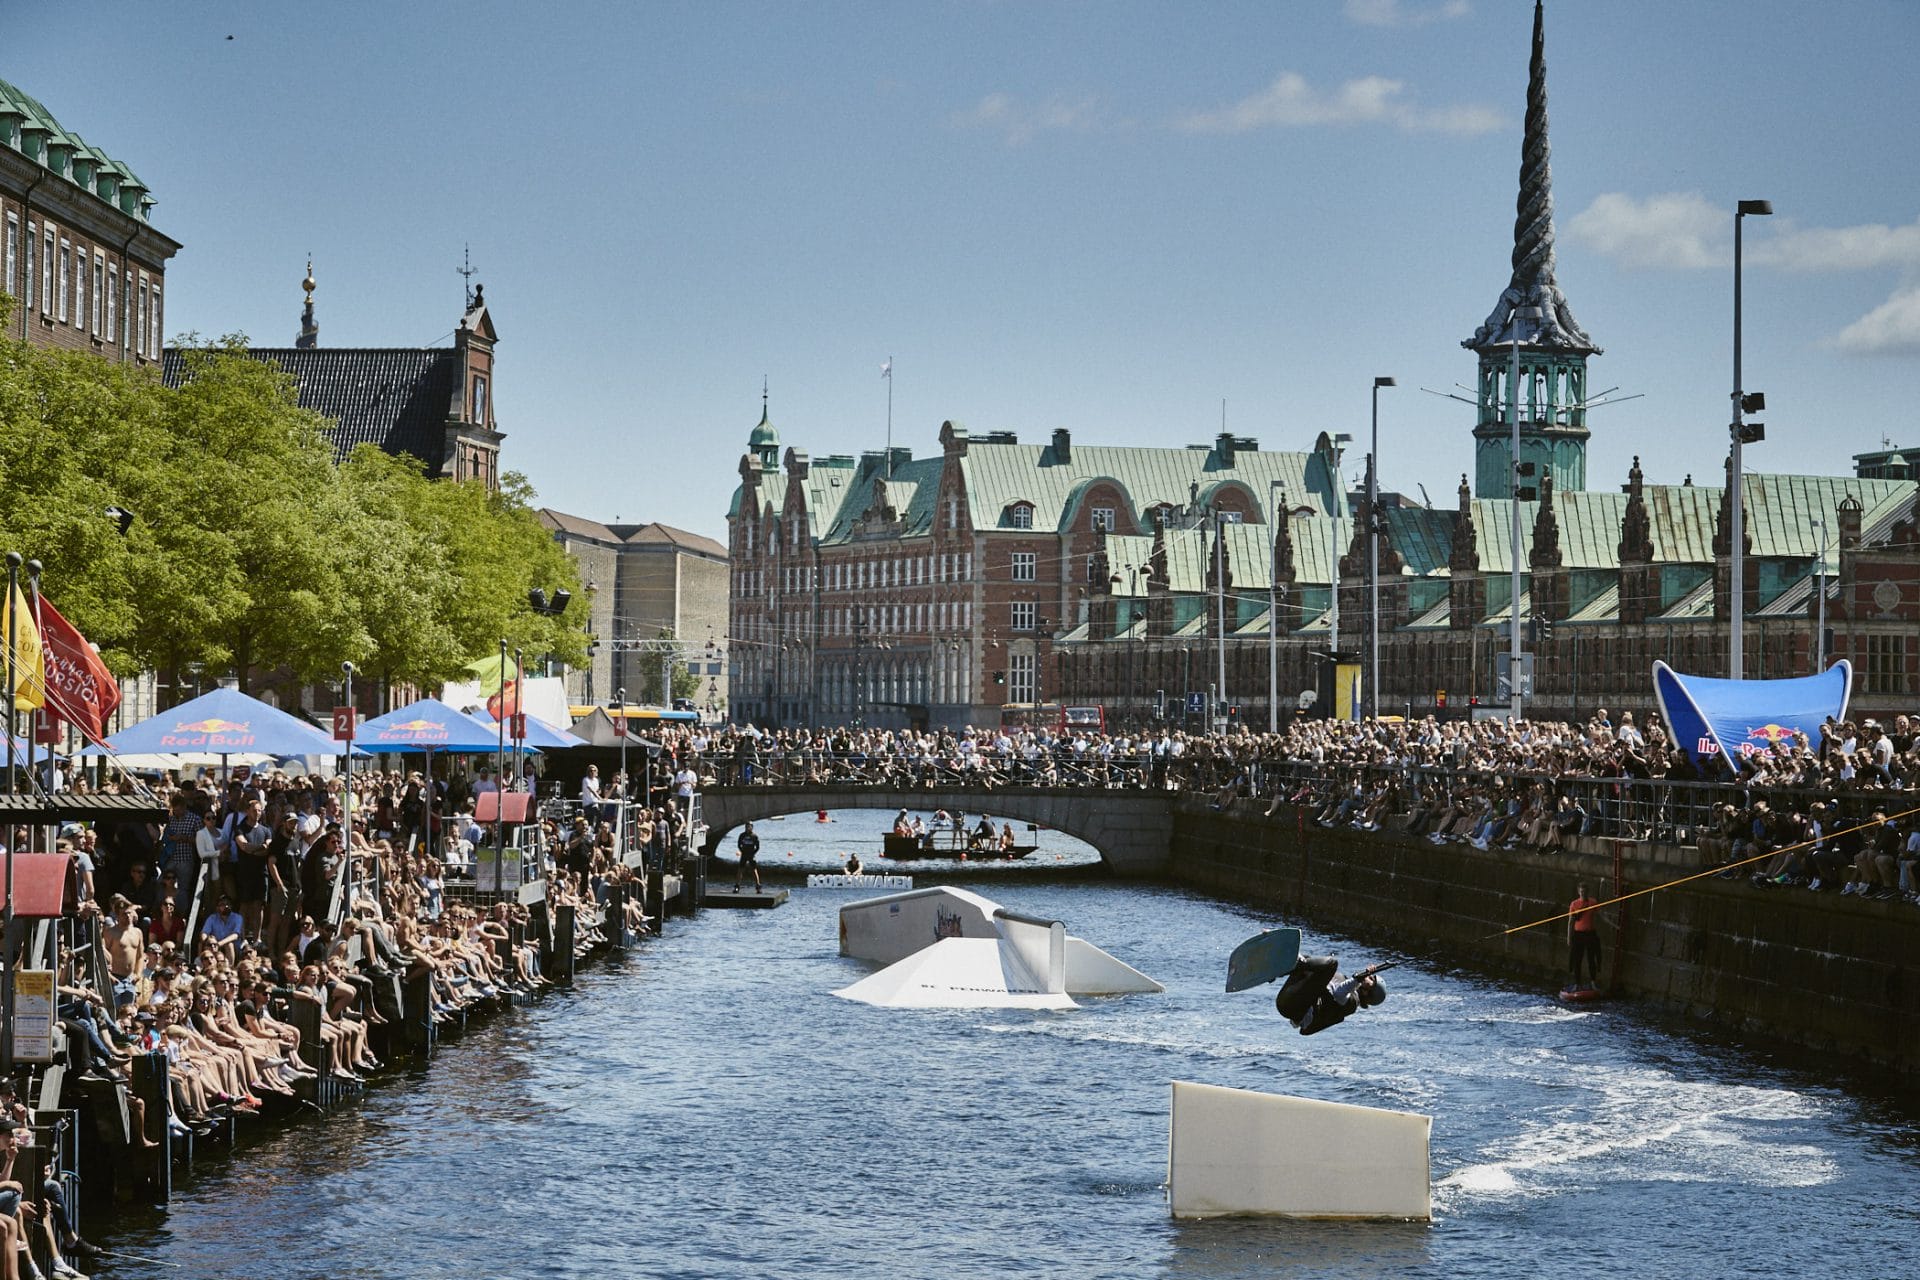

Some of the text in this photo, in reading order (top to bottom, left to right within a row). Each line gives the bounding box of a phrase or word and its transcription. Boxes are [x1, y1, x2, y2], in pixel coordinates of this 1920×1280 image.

[37, 708, 51, 730] 1
[338, 714, 348, 732] 2
[616, 720, 623, 731] 4
[160, 734, 256, 746] Red Bull
[378, 730, 449, 741] Red Bull
